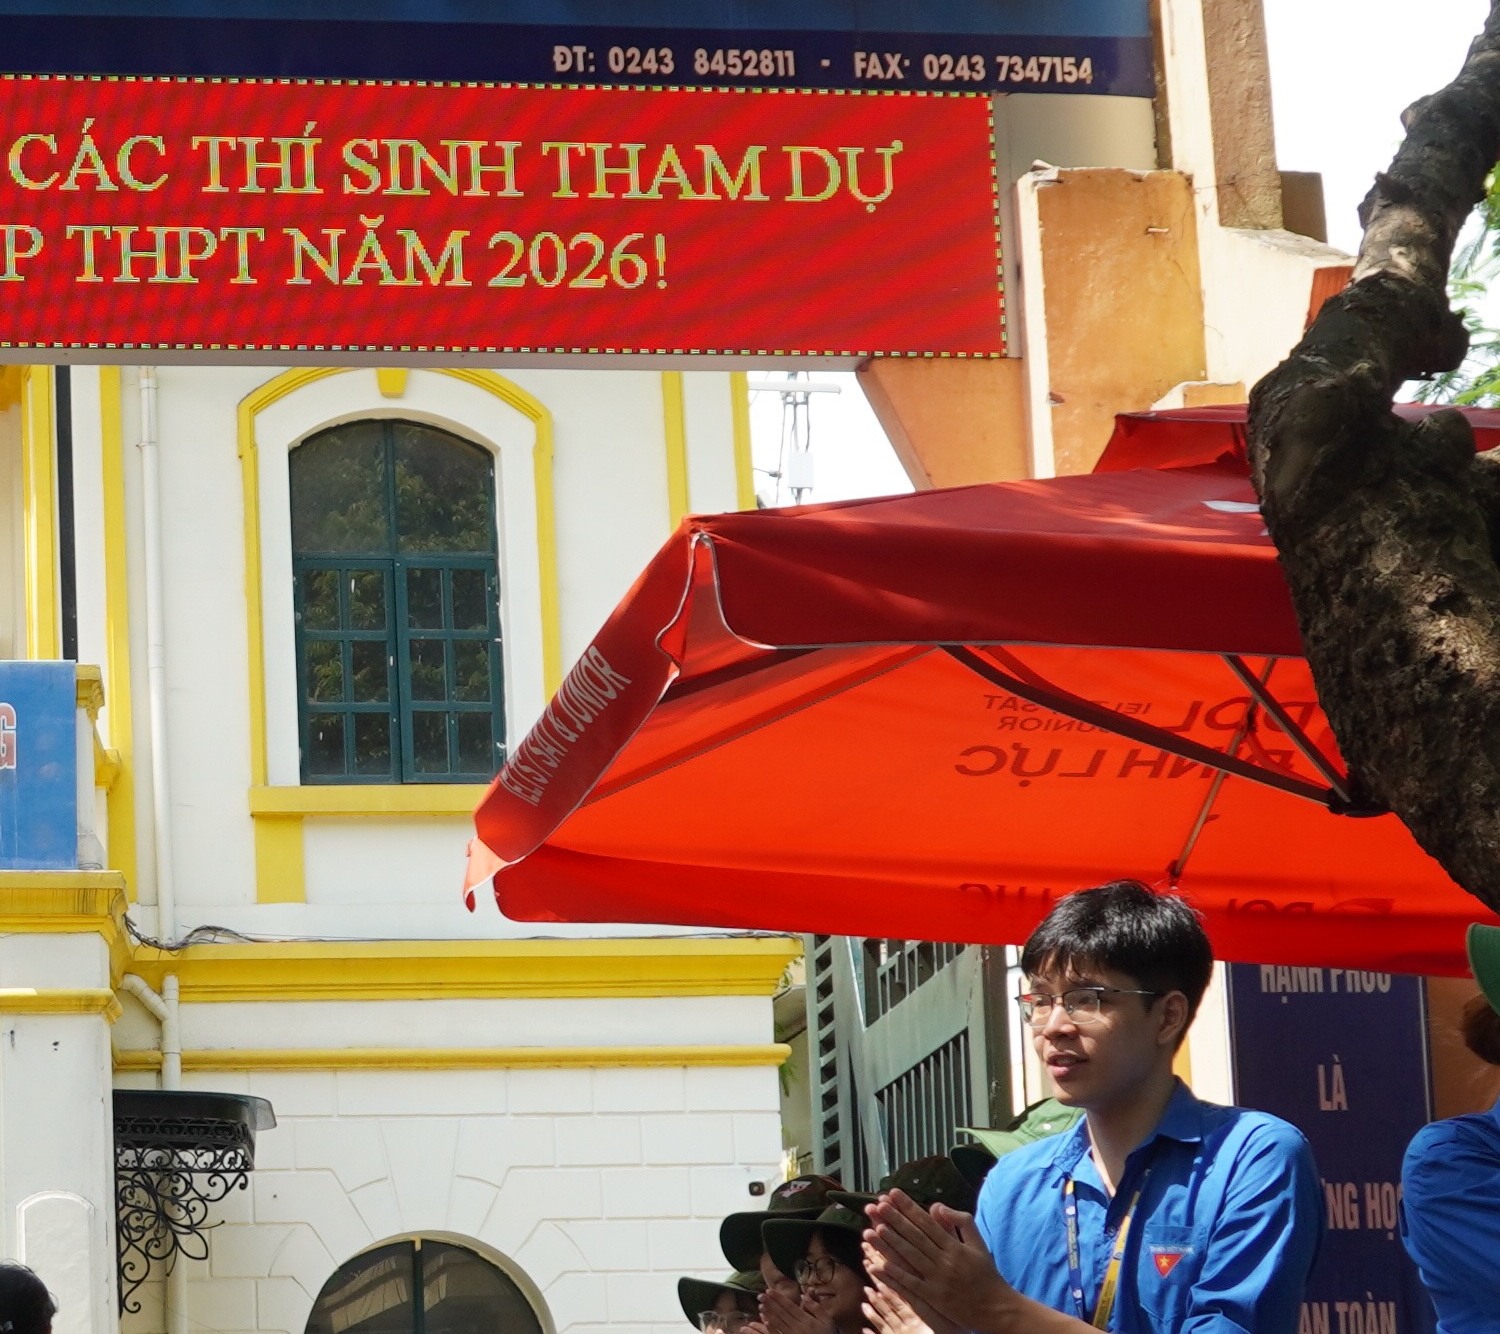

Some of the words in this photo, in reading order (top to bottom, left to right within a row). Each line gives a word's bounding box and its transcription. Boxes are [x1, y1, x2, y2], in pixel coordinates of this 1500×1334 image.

[553, 46, 595, 72] ĐT:
[608, 47, 674, 75] 0243
[694, 48, 796, 77] 8452811
[923, 54, 986, 82] 0243
[996, 55, 1093, 85] 7347154
[8, 118, 170, 193] CÁC
[193, 121, 325, 195] THÍ
[343, 139, 524, 199] SINH
[543, 141, 768, 202] THAM
[787, 139, 904, 213] DỰ
[66, 224, 273, 285] THPT
[282, 214, 473, 288] NĂM
[487, 230, 668, 291] 2026!
[558, 645, 633, 733] JUNIOR
[1317, 1054, 1348, 1111] LÀ
[1365, 1181, 1403, 1241] HỌ
